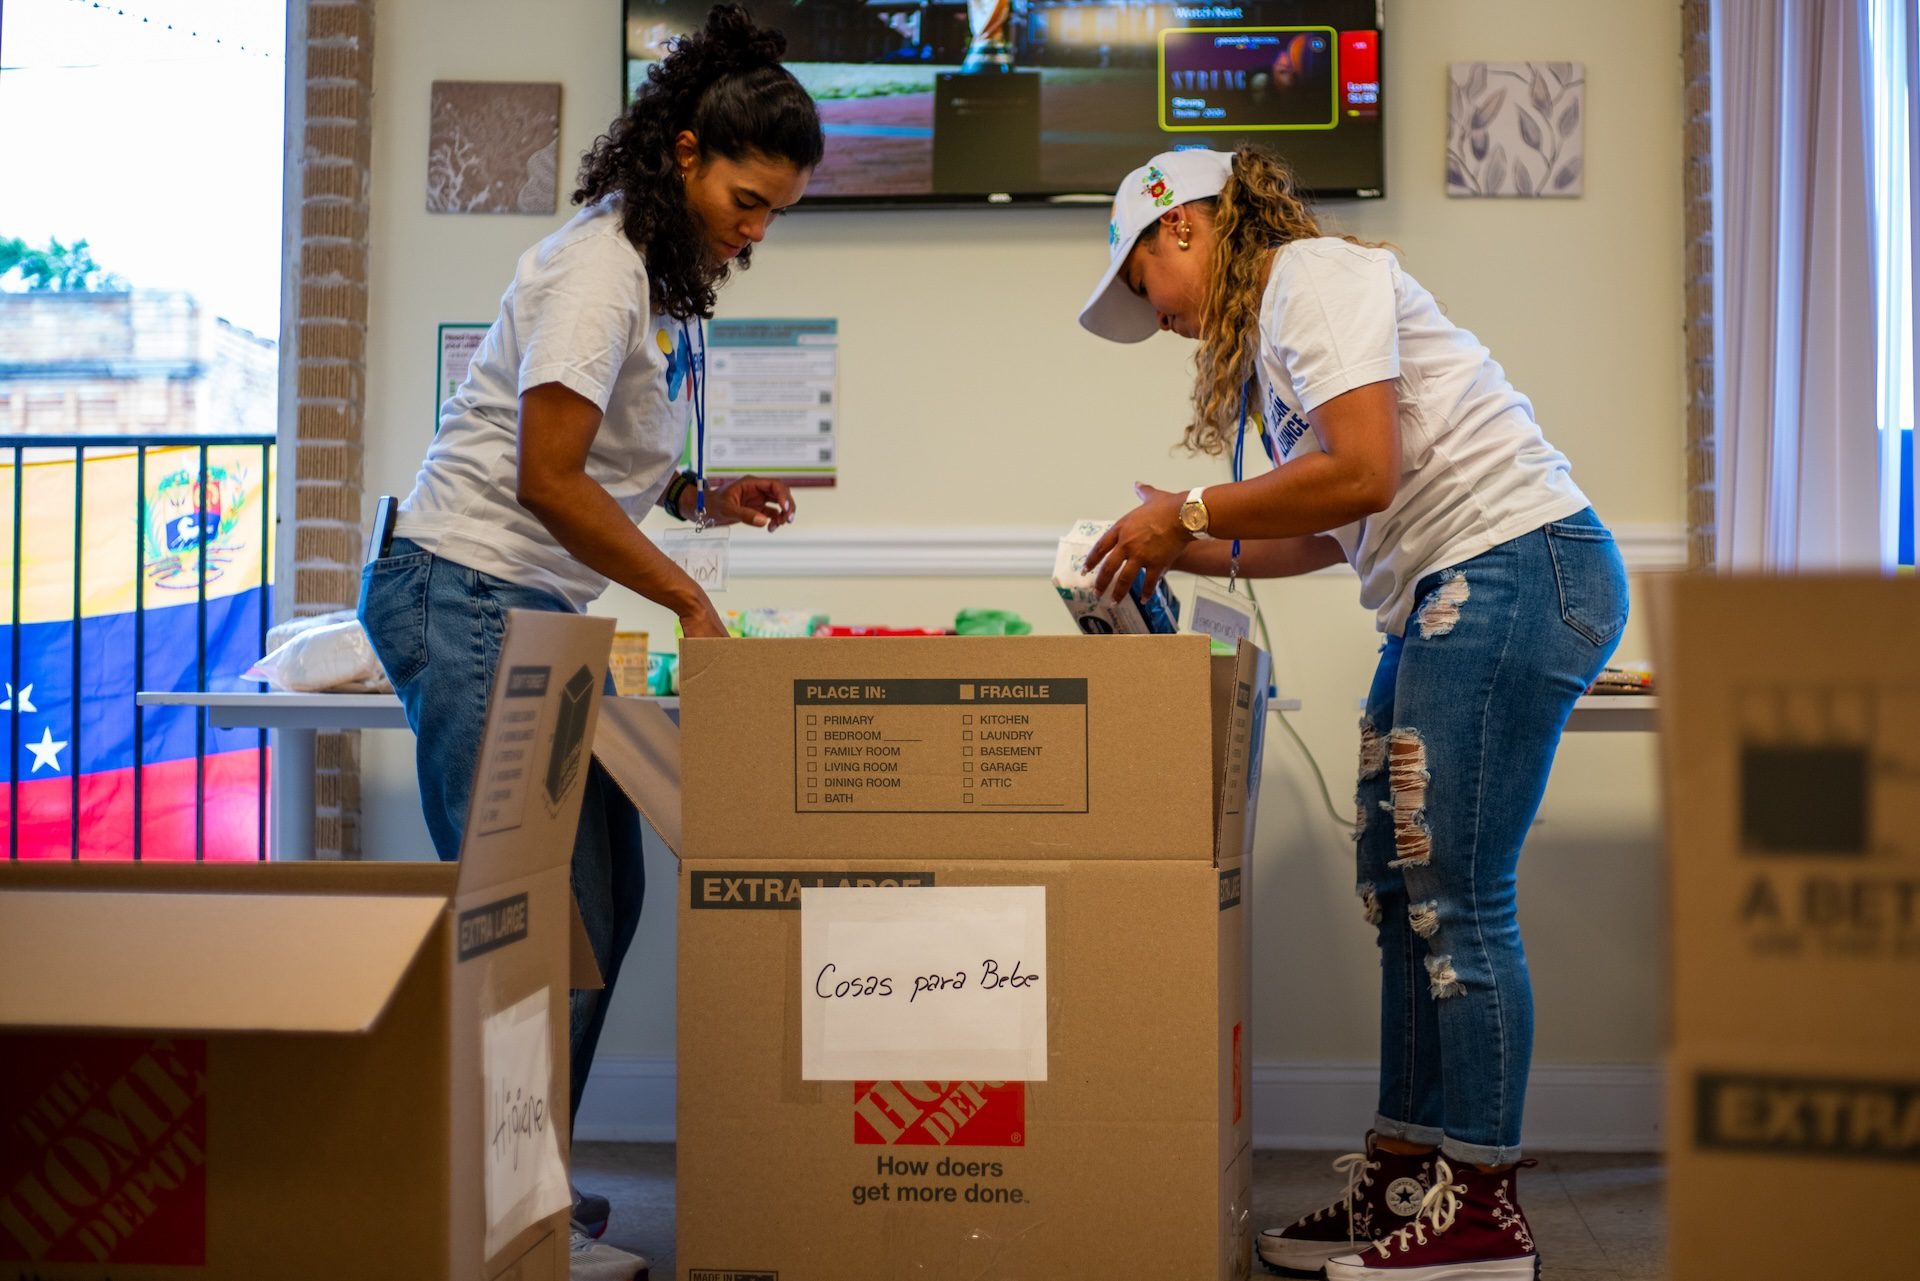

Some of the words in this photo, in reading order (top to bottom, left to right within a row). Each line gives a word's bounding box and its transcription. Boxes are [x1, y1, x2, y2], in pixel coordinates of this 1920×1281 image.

[807, 686, 860, 699] PLACE
[865, 686, 887, 698] IN:
[980, 685, 1050, 698] FRAGILE
[823, 715, 874, 725] PRIMARY
[980, 715, 1029, 725] KITCHEN
[824, 731, 881, 741] BEDROOM
[980, 731, 1034, 740] LAUNDRY
[824, 747, 863, 756] FAMILY
[866, 747, 901, 756] ROOM
[980, 746, 1043, 756] BASEMENT
[824, 762, 860, 772] LIVING
[863, 762, 898, 772] ROOM
[980, 762, 1028, 772] GARAGE
[824, 778, 863, 788] DINING
[866, 778, 901, 788] ROOM
[980, 778, 1012, 788] ATTIC
[824, 794, 853, 803] BATH
[703, 878, 801, 902] EXTRA
[462, 913, 494, 952] EXTRA
[495, 902, 525, 938] LARGE
[815, 963, 893, 998] Cosas
[911, 971, 967, 1003] para
[980, 959, 1039, 989] Bebe
[877, 1155, 928, 1176] How
[936, 1157, 1003, 1177] doers
[852, 1183, 890, 1205] get
[897, 1186, 957, 1201] more
